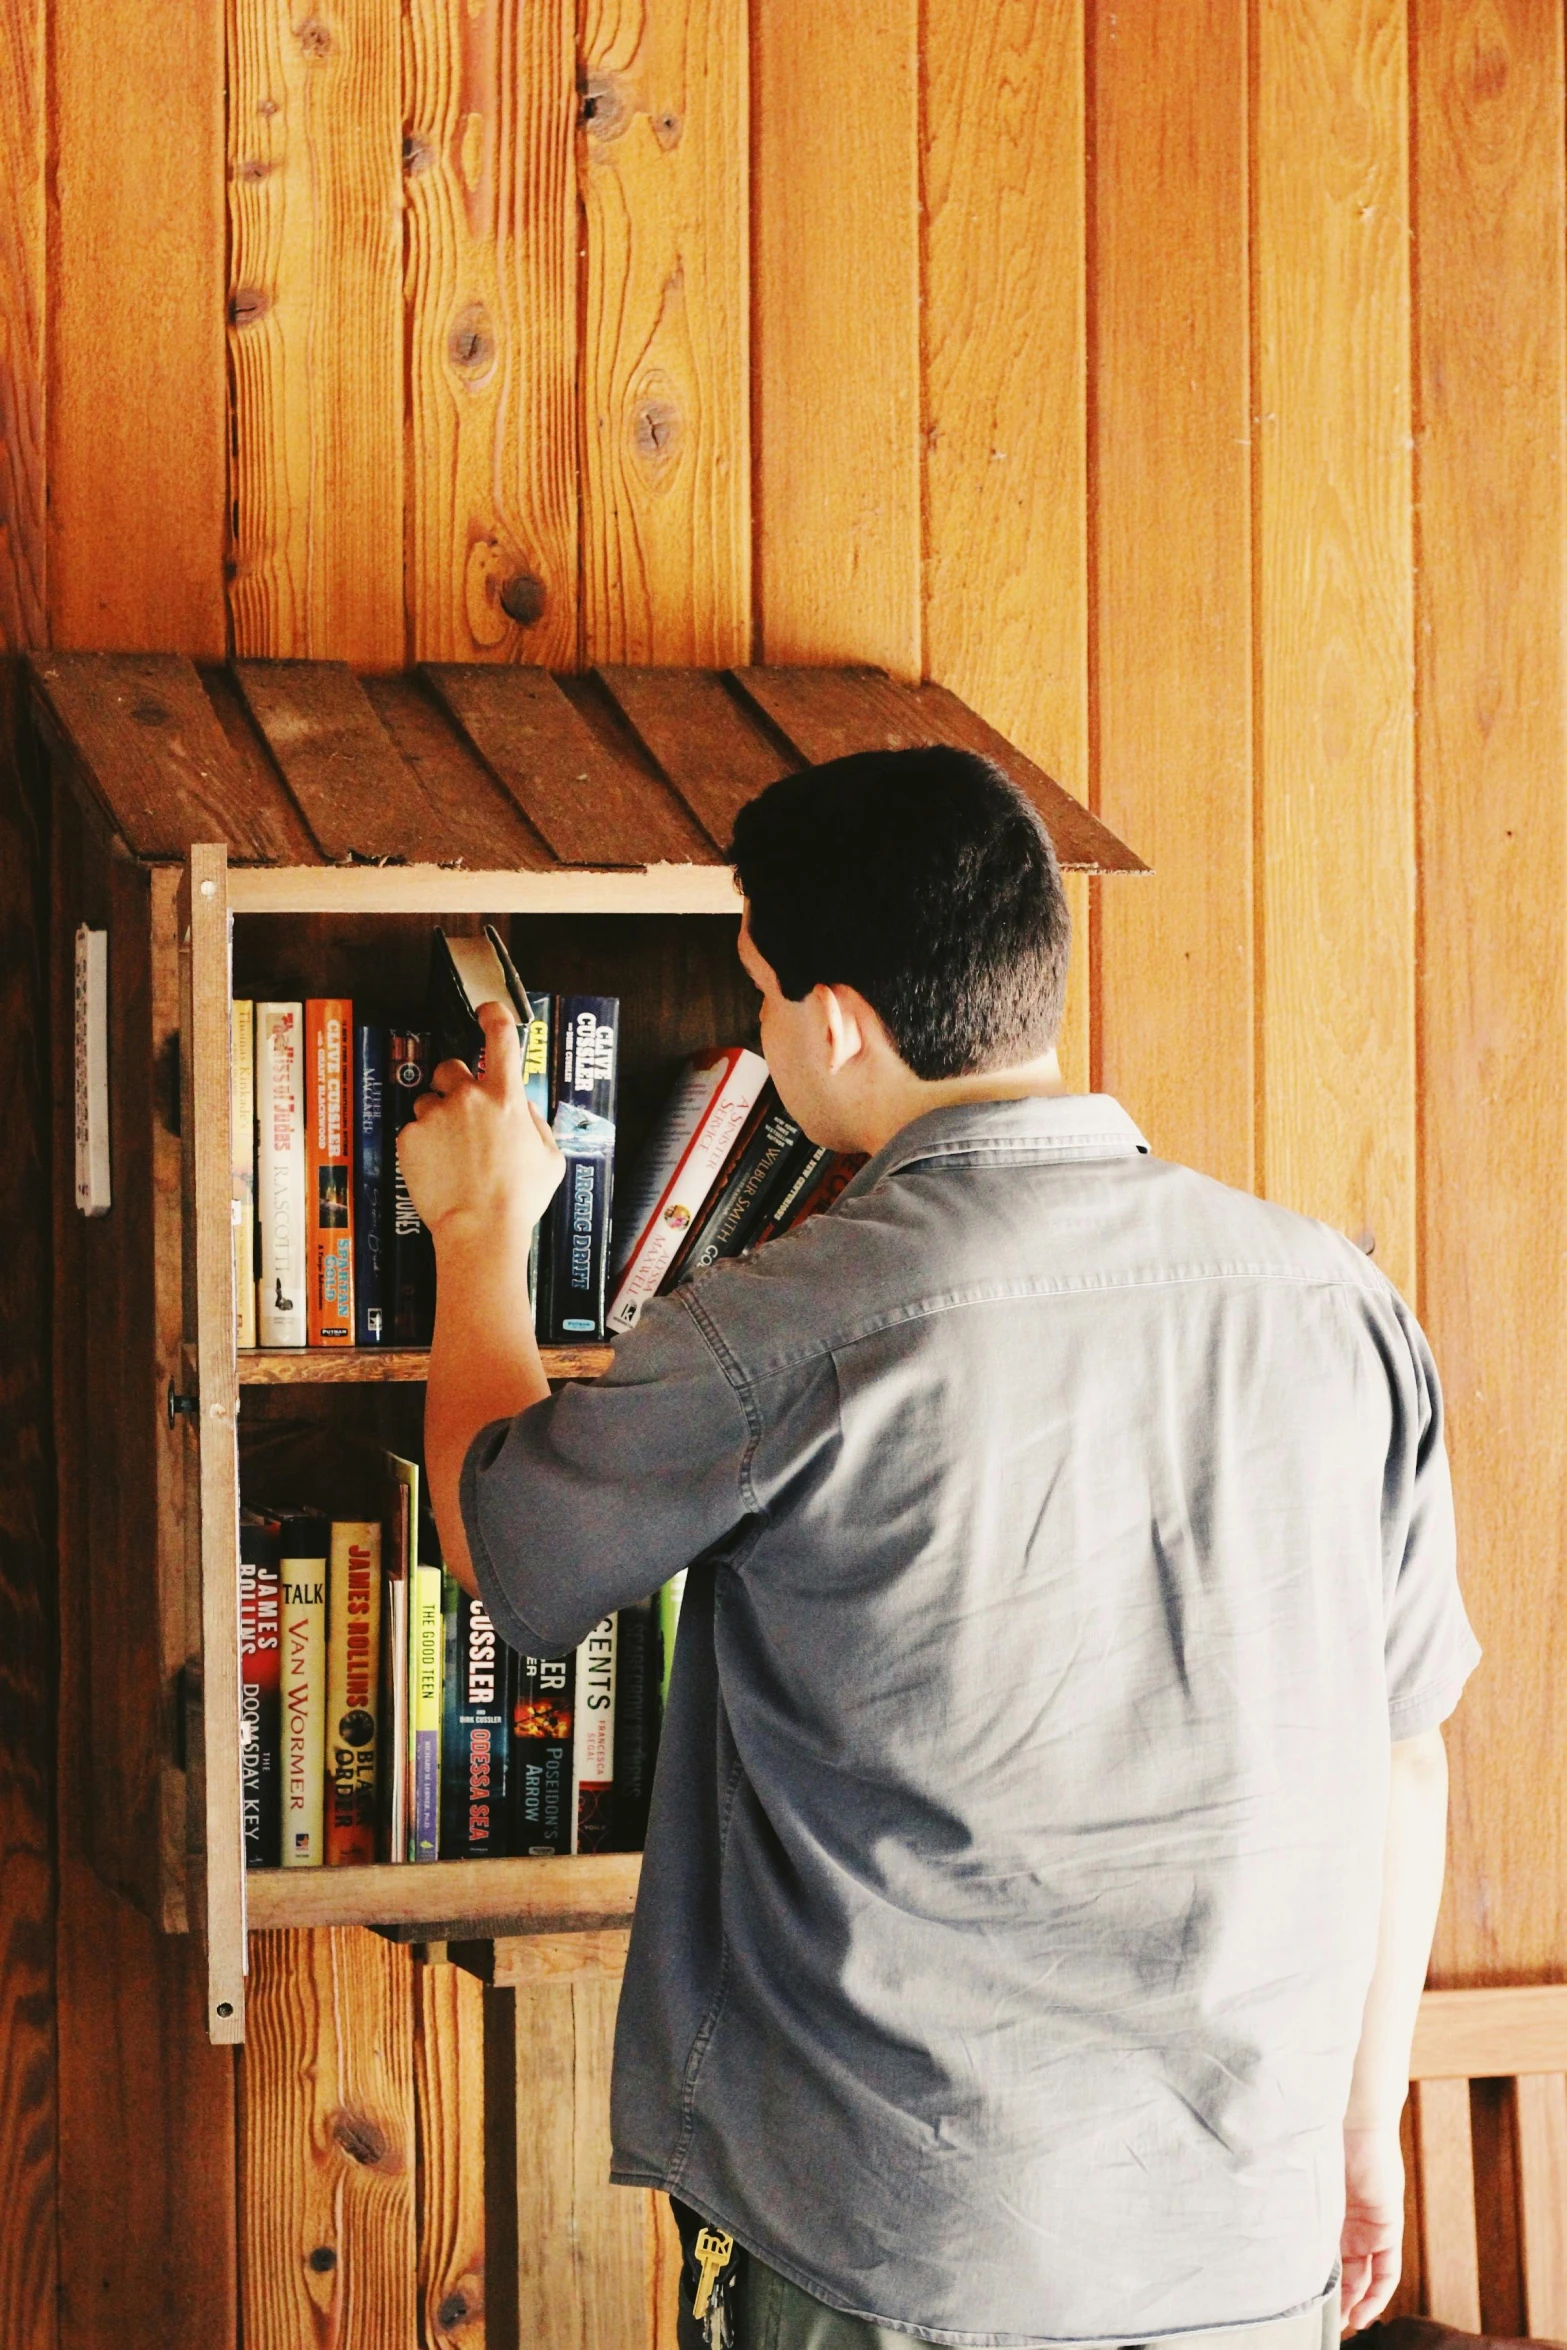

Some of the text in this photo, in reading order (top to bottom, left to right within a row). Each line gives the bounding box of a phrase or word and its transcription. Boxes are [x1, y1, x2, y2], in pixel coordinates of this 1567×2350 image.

[239, 1011, 250, 1061] Thomas
[528, 1020, 548, 1074] CLIVE
[575, 1012, 596, 1091] CUSSLER
[593, 1026, 613, 1080] CLIVE
[274, 1085, 295, 1101] of
[327, 1019, 341, 1157] CLIVE CUSSLER
[273, 1103, 295, 1151] Judas
[318, 1085, 327, 1149] BLACKWOOD
[699, 1098, 734, 1151] SERVICE
[706, 1112, 742, 1170] SINISTER
[744, 1148, 781, 1196] WILBUR
[801, 1159, 817, 1179] NEW
[717, 1197, 750, 1242] SMITH
[773, 1177, 806, 1221] CENTURIONS
[572, 1164, 594, 1290] ARCTIC DRIFT
[325, 1255, 337, 1302] GOLD
[338, 1239, 350, 1317] SPARTAN
[627, 1234, 666, 1295] MAXWELL
[643, 1249, 670, 1293] ALYSSA
[258, 1568, 278, 1649] JAMES
[283, 1583, 324, 1604] TALK
[346, 1544, 371, 1708] JAMES ROLLINS
[421, 1604, 435, 1699] THE GOOD TEEN
[289, 1619, 308, 1811] VAN WORMER
[475, 1715, 502, 1723] CUSSLER
[469, 1729, 491, 1800] ODESSA
[587, 1733, 596, 1761] SEGAL
[596, 1720, 606, 1775] FRANCESCA
[335, 1749, 354, 1828] ORDER
[356, 1750, 374, 1828] BLACK
[525, 1764, 543, 1822] ARROW
[544, 1747, 564, 1839] POSEIDON'S
[244, 1800, 260, 1840] KEY
[469, 1804, 490, 1841] SEA
